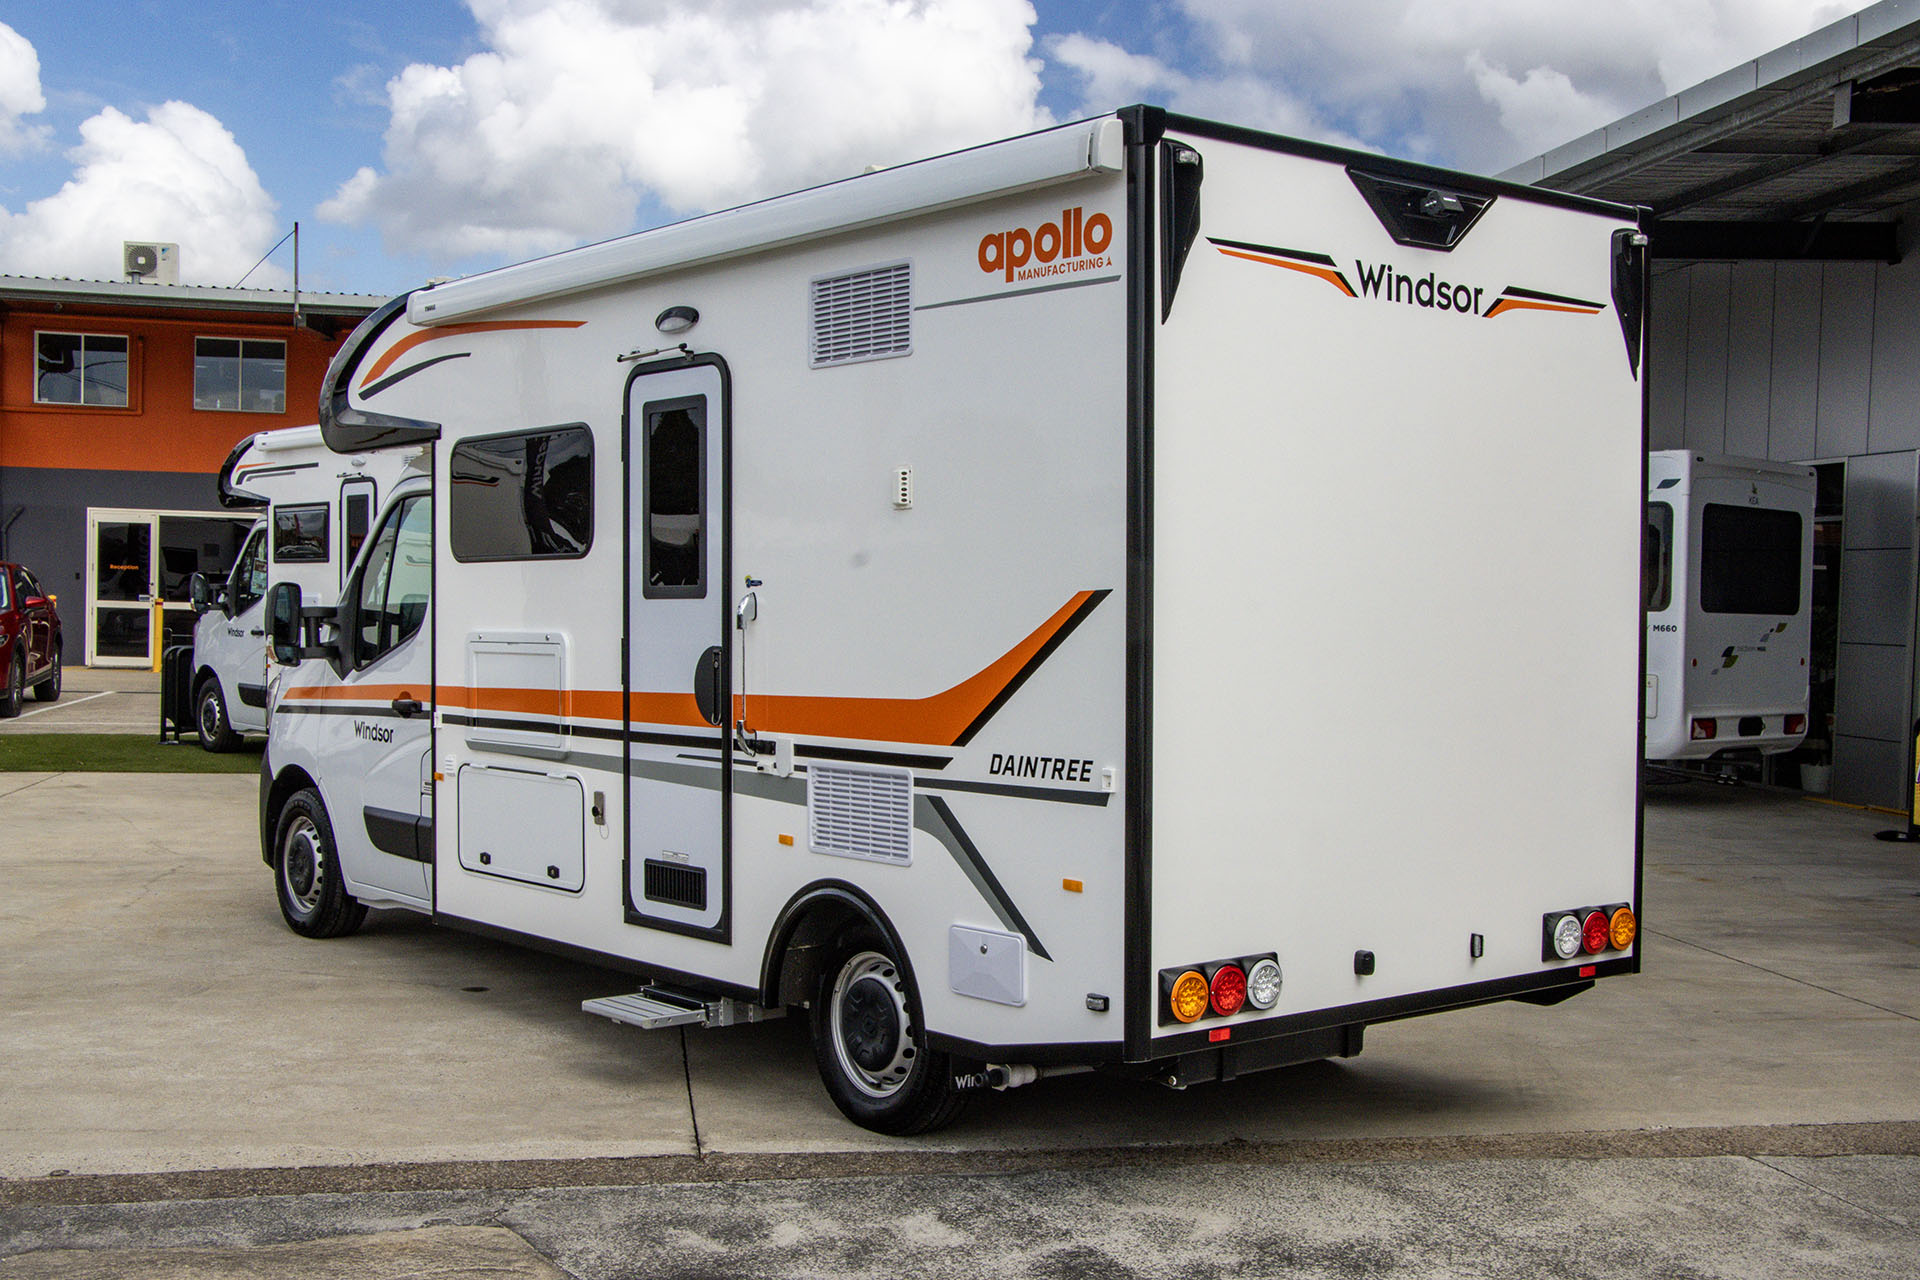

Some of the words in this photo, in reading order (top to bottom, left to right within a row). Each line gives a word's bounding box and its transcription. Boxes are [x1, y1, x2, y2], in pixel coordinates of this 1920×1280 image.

[978, 206, 1113, 283] apollo
[1017, 256, 1104, 281] MANUFACTURING
[1355, 259, 1484, 315] Windsor
[109, 563, 139, 571] Reception
[227, 626, 245, 638] Windsor
[1652, 624, 1678, 633] M660
[354, 719, 394, 743] Windsor
[989, 753, 1094, 783] DAINTREE
